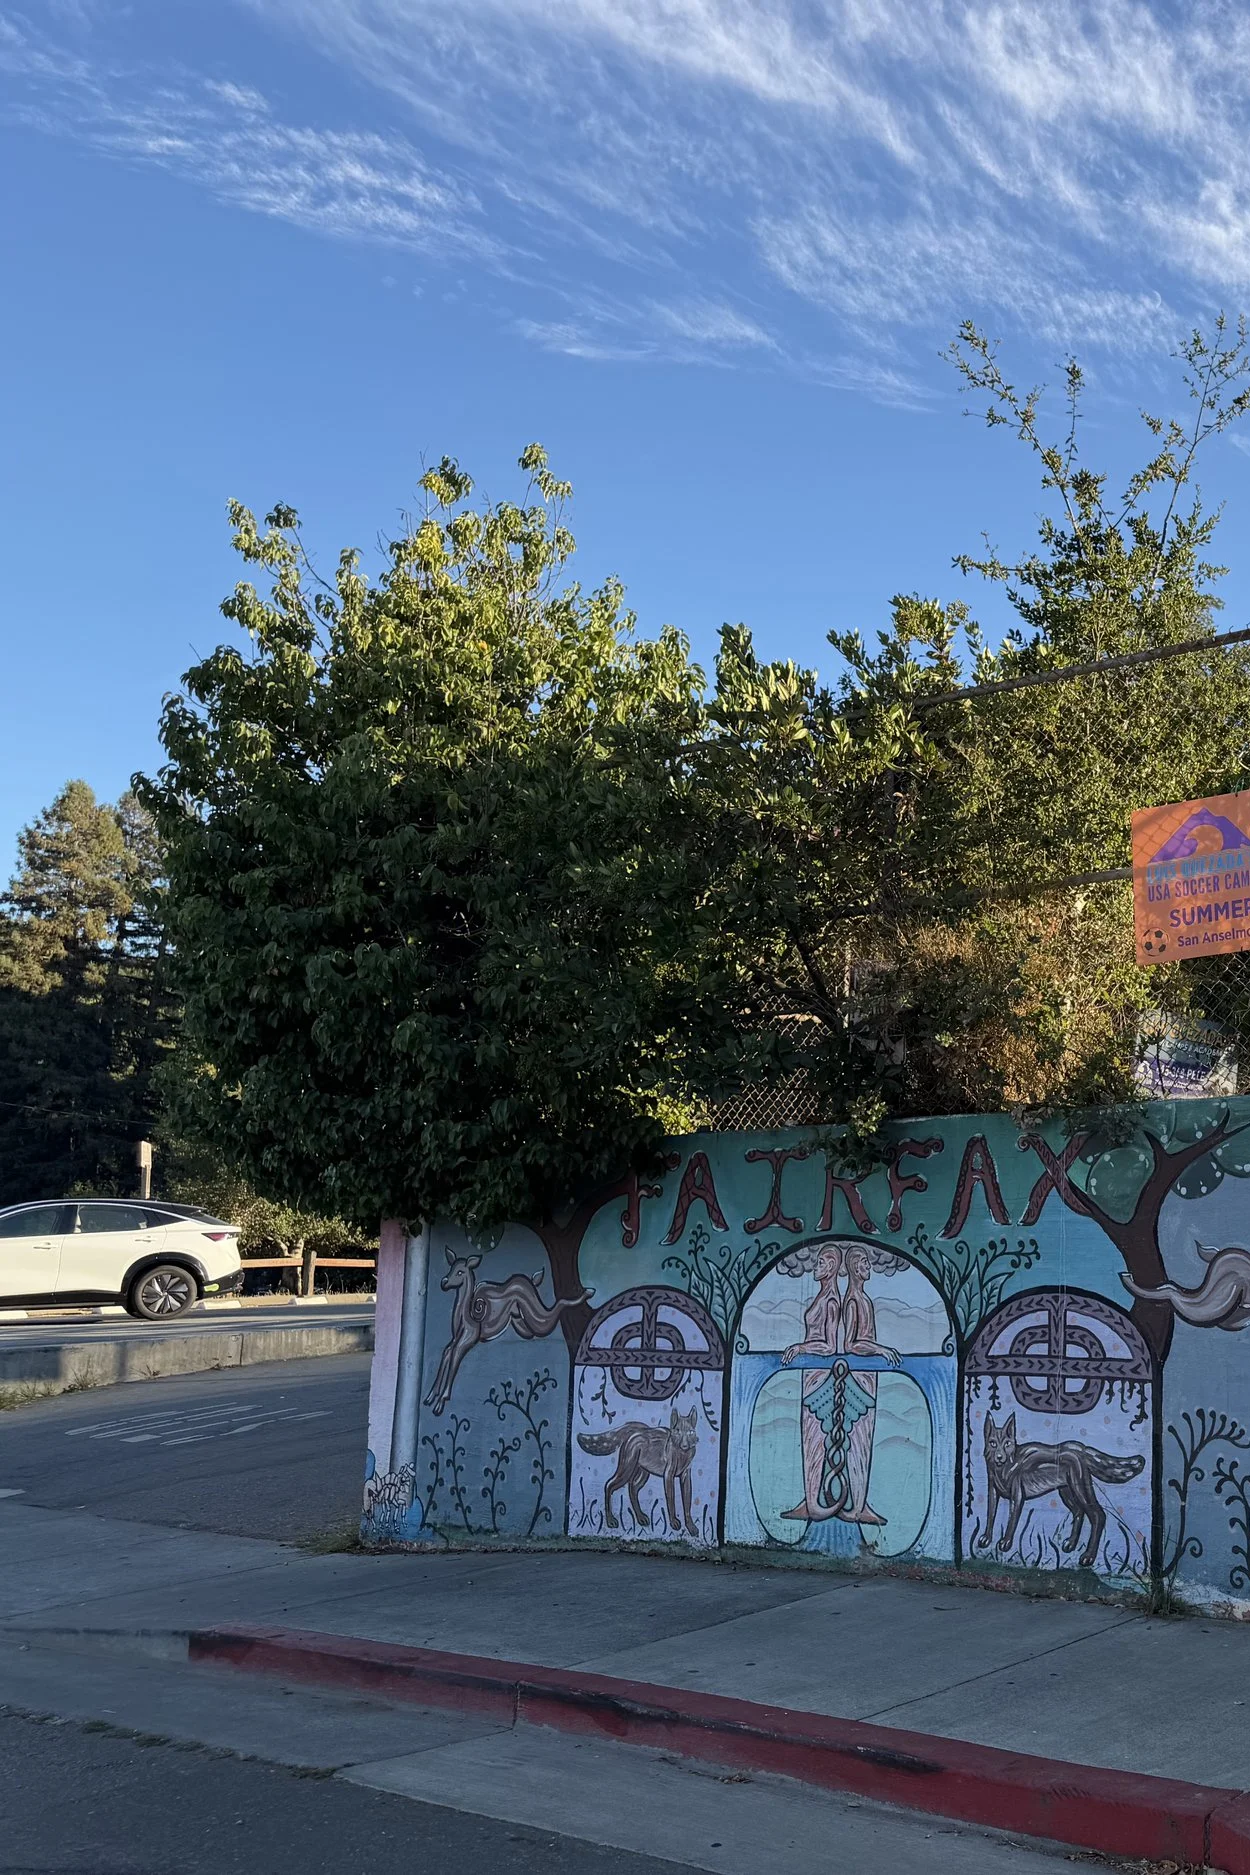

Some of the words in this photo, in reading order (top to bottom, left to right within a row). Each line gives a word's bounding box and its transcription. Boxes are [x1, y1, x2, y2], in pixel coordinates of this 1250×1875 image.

[1147, 863, 1177, 884] LUIS
[1148, 884, 1171, 902] USA
[1175, 875, 1220, 898] SOCCER
[1177, 935, 1199, 947] San
[620, 1132, 1097, 1249] FAIRFAX
